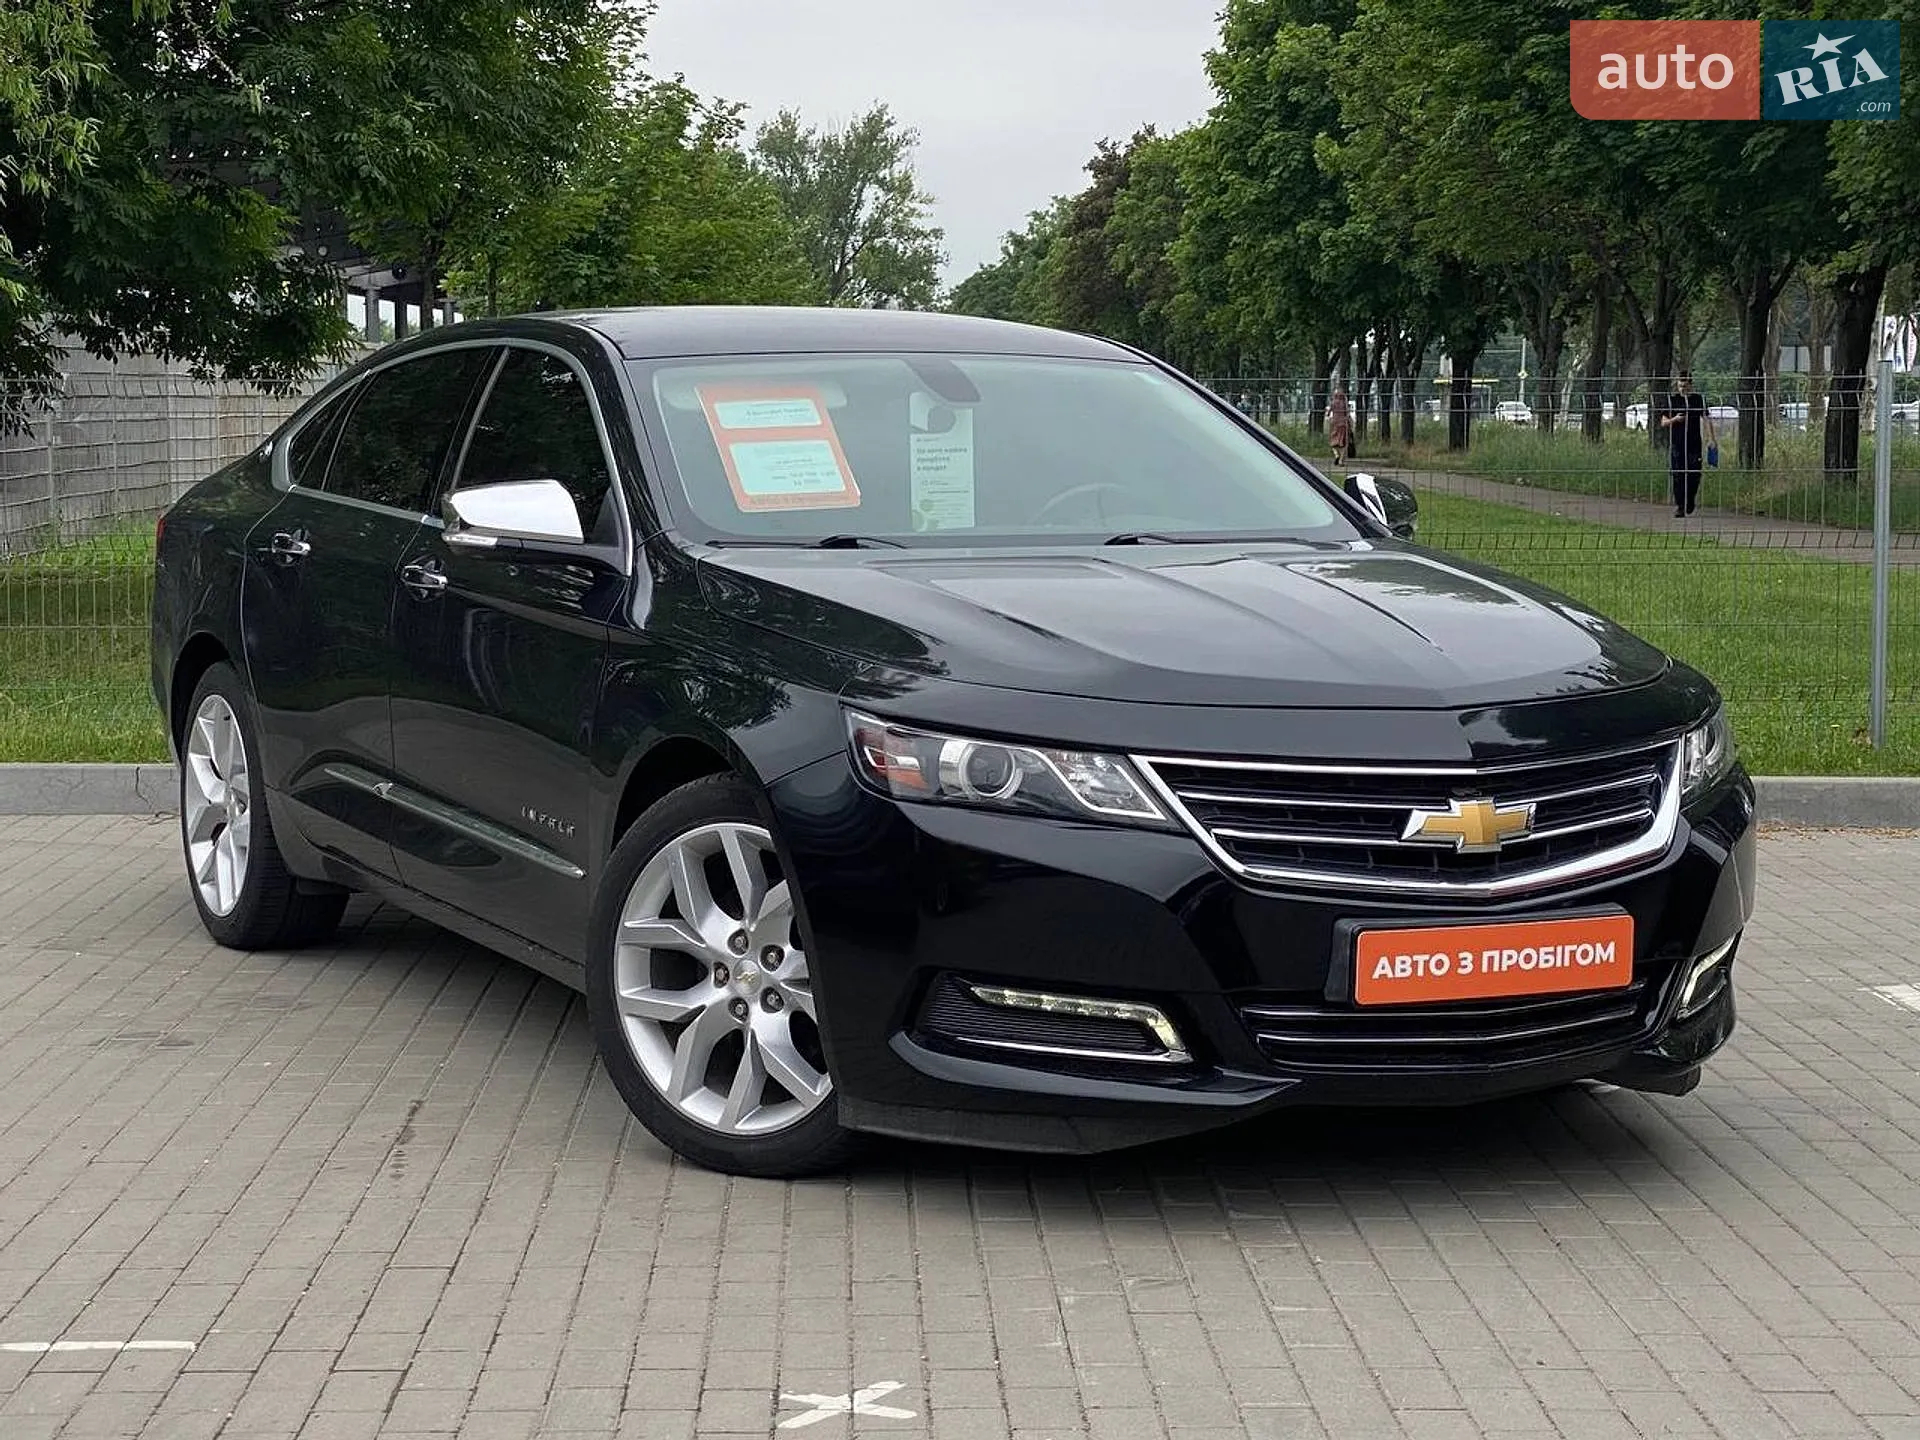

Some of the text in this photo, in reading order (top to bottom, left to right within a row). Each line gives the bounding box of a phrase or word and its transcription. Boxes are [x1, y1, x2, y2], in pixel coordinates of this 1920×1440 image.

[1372, 941, 1617, 979] АВТО З ПРОБІГОМ
